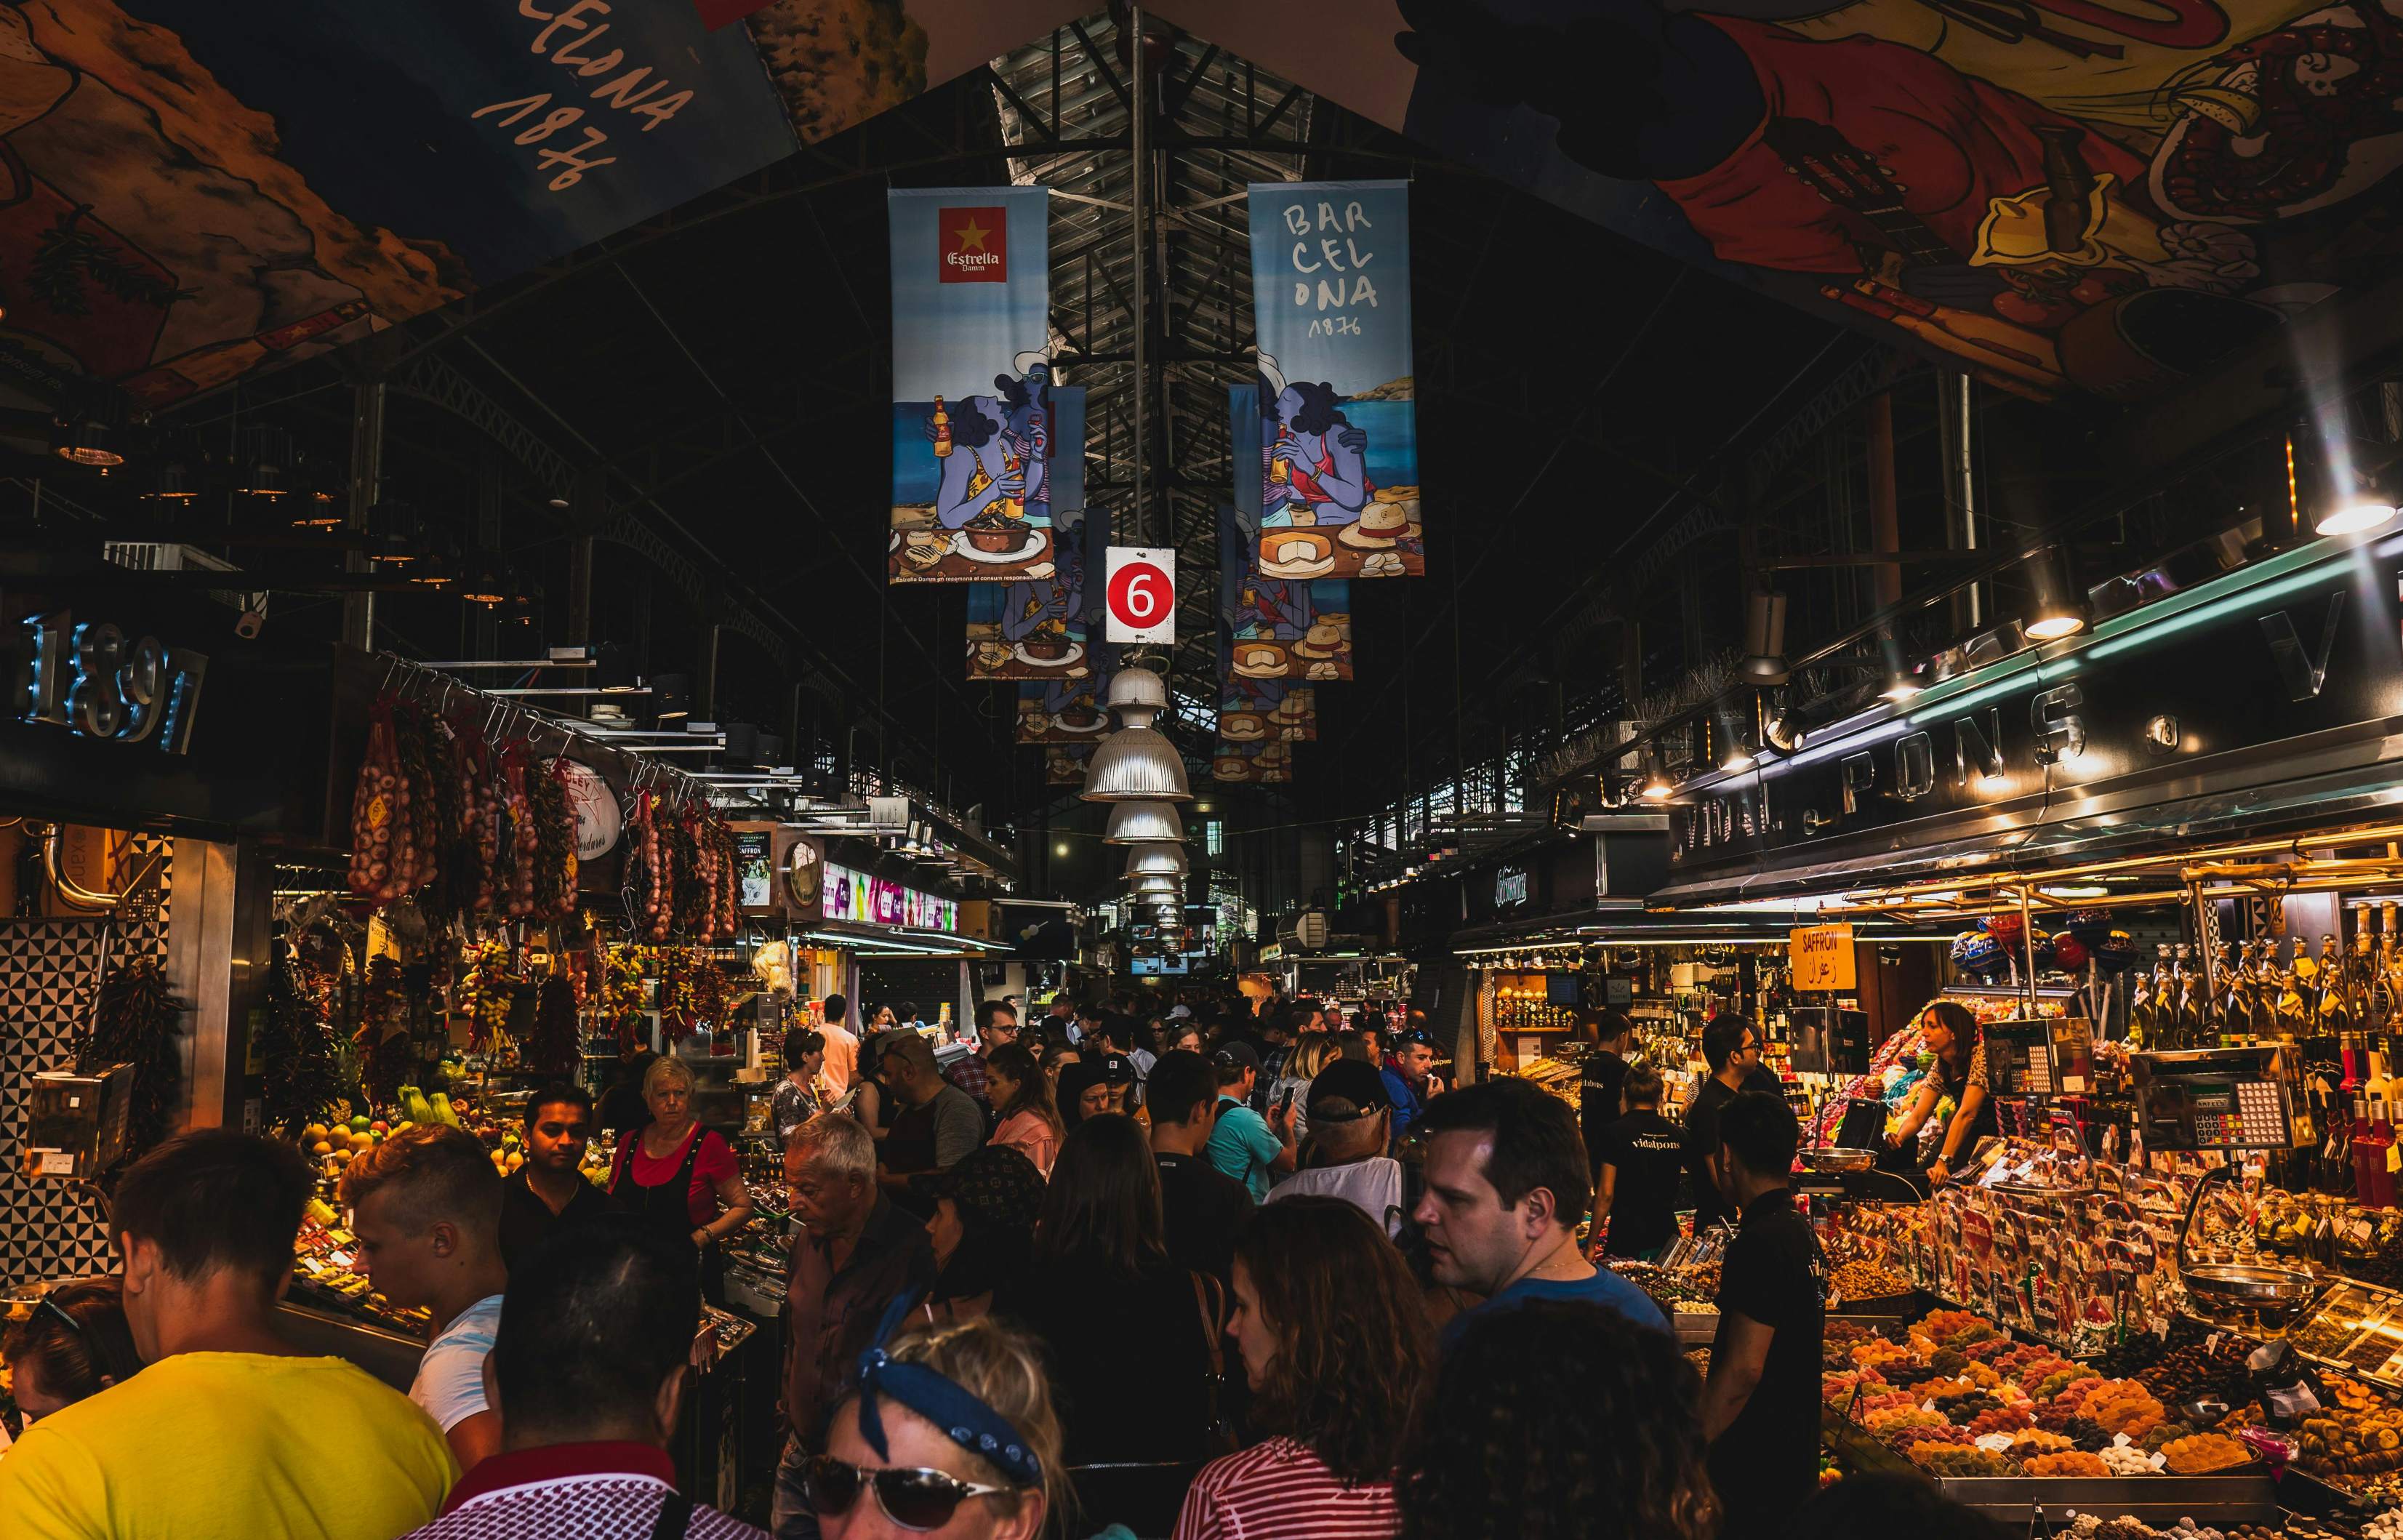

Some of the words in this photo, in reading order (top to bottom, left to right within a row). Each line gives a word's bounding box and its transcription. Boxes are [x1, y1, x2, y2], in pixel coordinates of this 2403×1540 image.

[471, 92, 617, 191] 1876
[1283, 201, 1372, 236] BAR
[947, 251, 999, 265] Estrella
[1292, 238, 1373, 273] CEL
[1295, 275, 1378, 311] ONA
[1309, 316, 1361, 338] 1876
[1126, 573, 1155, 617] 6
[1840, 682, 2087, 815] PONS
[565, 771, 590, 792] OLEY
[840, 883, 850, 902] Fruit
[1802, 931, 1837, 953] SAFFRON
[1632, 1139, 1680, 1150] vidalpons
